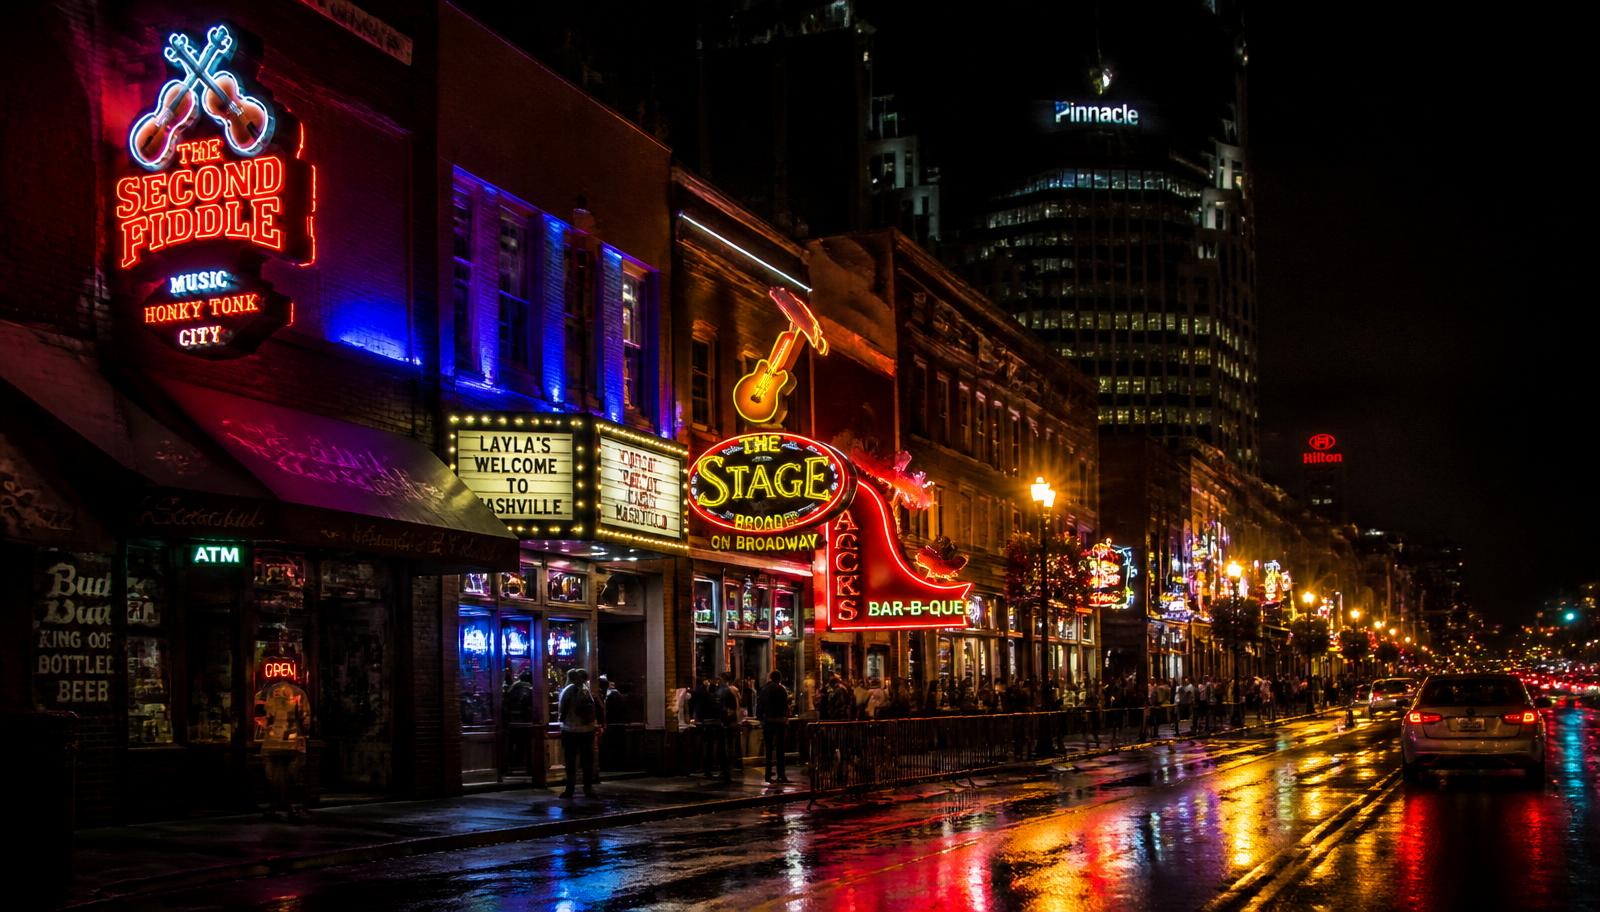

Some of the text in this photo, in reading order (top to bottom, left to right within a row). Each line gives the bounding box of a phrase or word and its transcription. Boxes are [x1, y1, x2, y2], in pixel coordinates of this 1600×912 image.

[1055, 101, 1139, 125] Pinnacle
[177, 138, 221, 164] THE
[115, 155, 283, 219] SECOND
[121, 196, 281, 268] FIDDLE
[170, 269, 228, 294] MUSIC
[144, 293, 259, 324] HONKY TONK
[179, 325, 222, 347] CITY
[480, 435, 552, 454] LAYLA'S
[739, 434, 782, 455] THE
[473, 456, 558, 475] WELCOME
[1302, 451, 1342, 465] Hilton
[506, 478, 529, 494] TO
[696, 455, 833, 507] STAGE
[480, 497, 563, 515] ASHVILLE
[711, 532, 819, 552] ON BROADWAY
[193, 545, 240, 563] ATM
[868, 599, 965, 618] BAR-B-QUE
[38, 629, 82, 649] KING
[264, 662, 297, 681] OPEN
